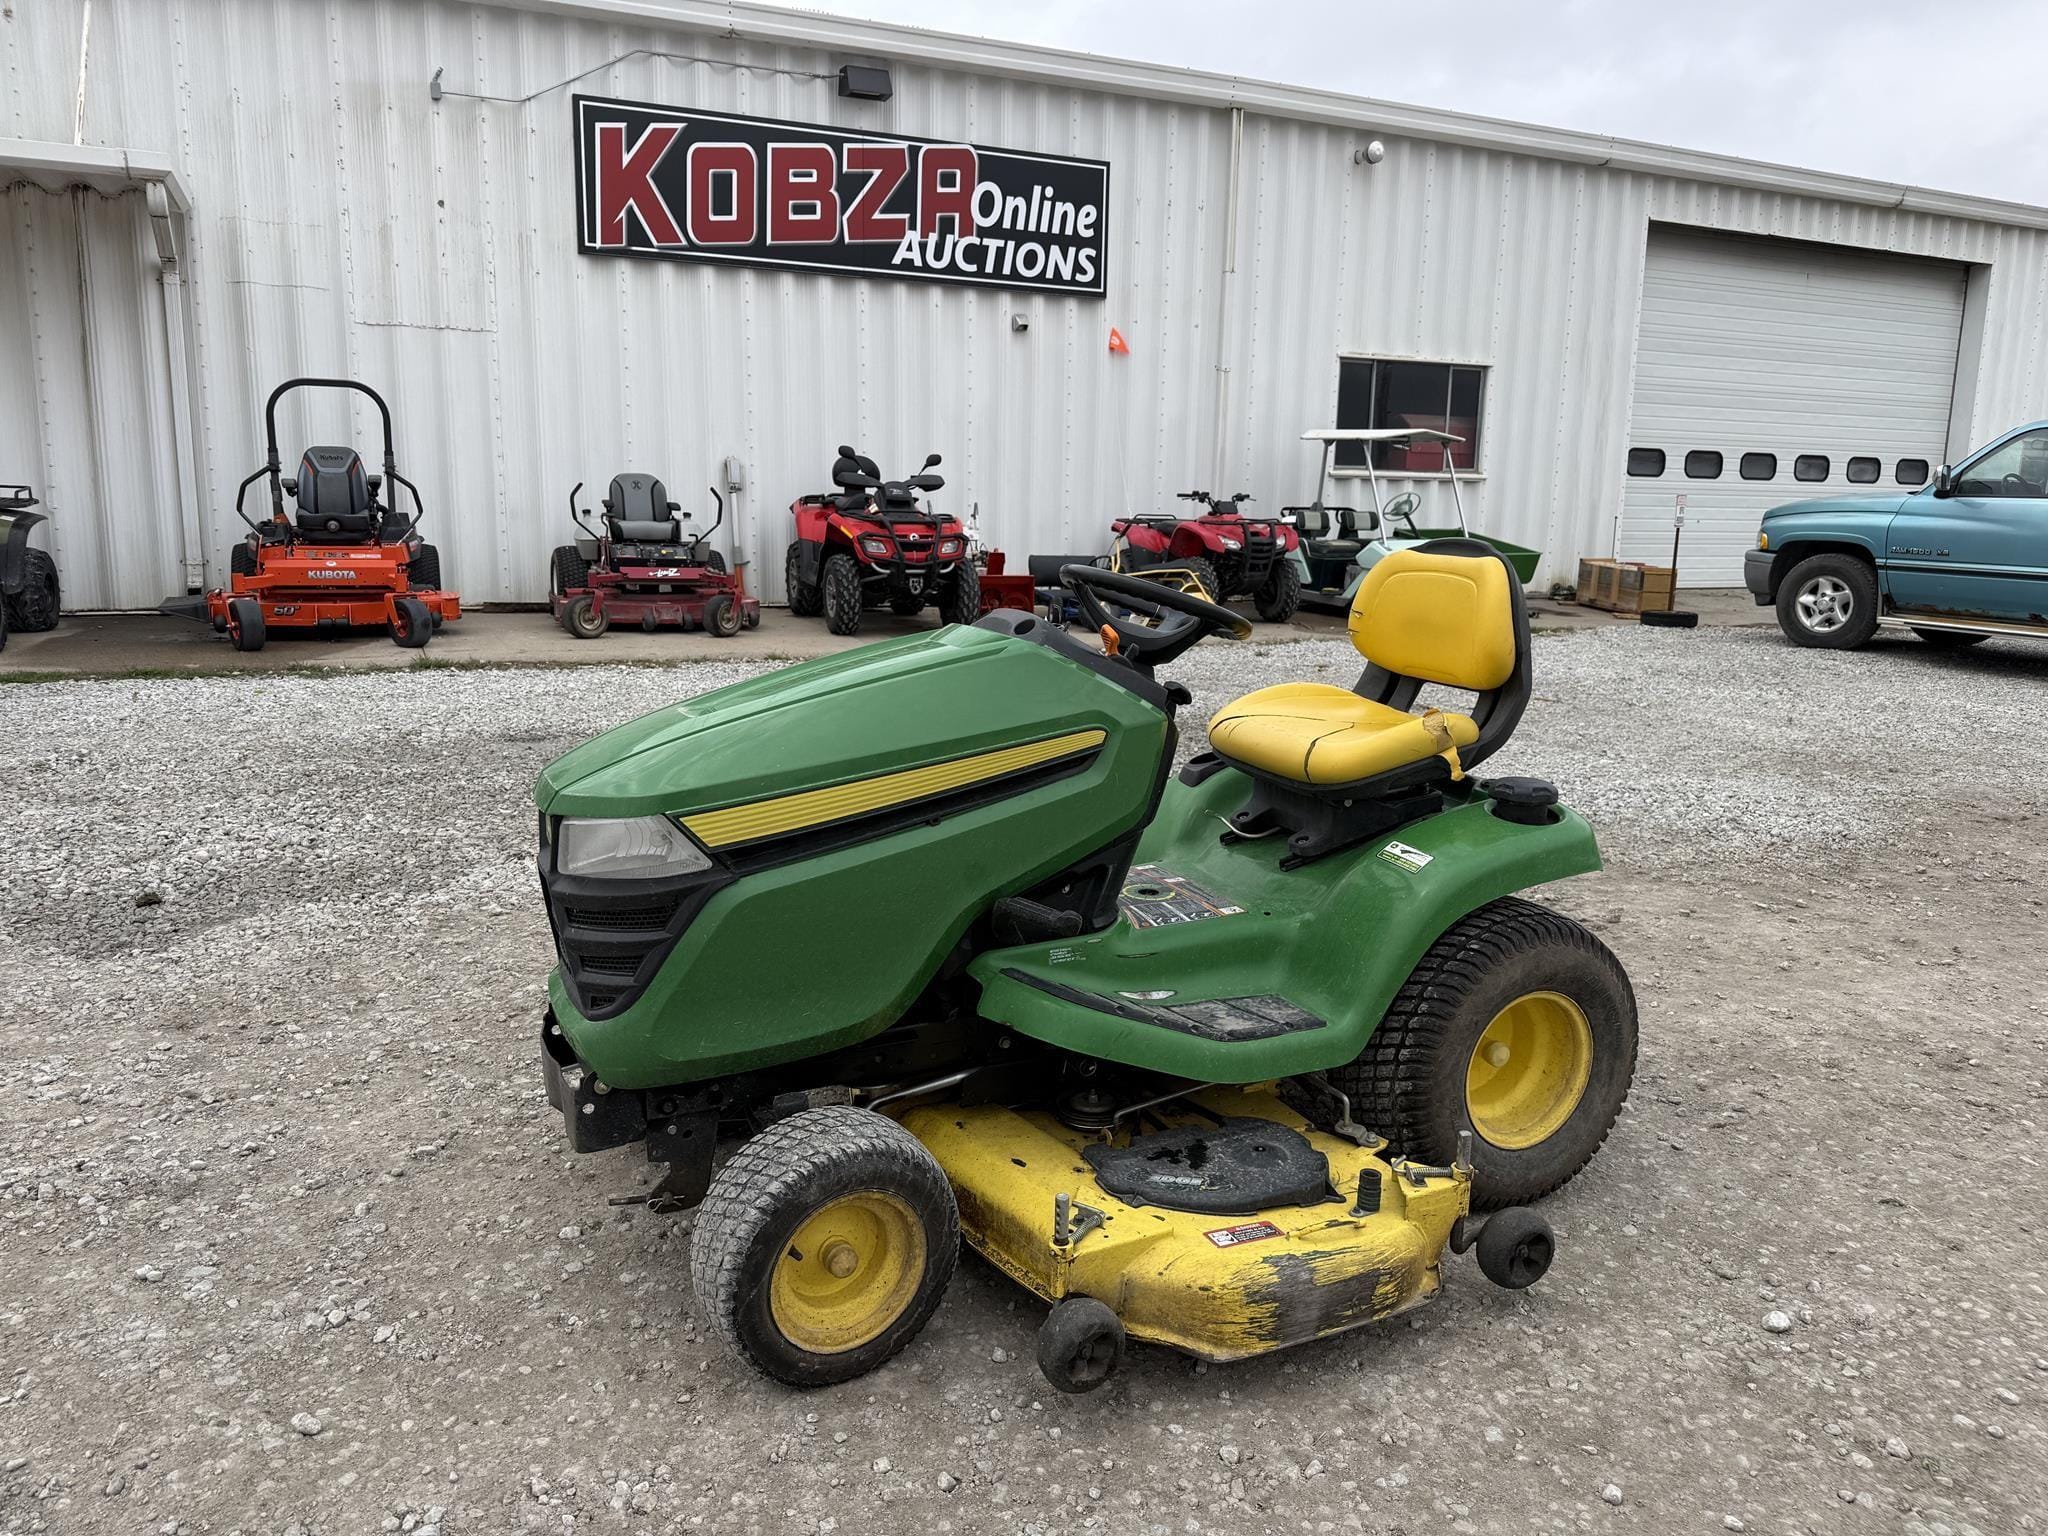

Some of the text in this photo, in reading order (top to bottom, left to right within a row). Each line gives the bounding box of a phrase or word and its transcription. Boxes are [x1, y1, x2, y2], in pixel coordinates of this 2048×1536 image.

[594, 122, 979, 248] KOBZA
[970, 181, 1098, 238] Online
[891, 230, 1097, 283] AUCTIONS
[308, 570, 357, 579] KUBOTA
